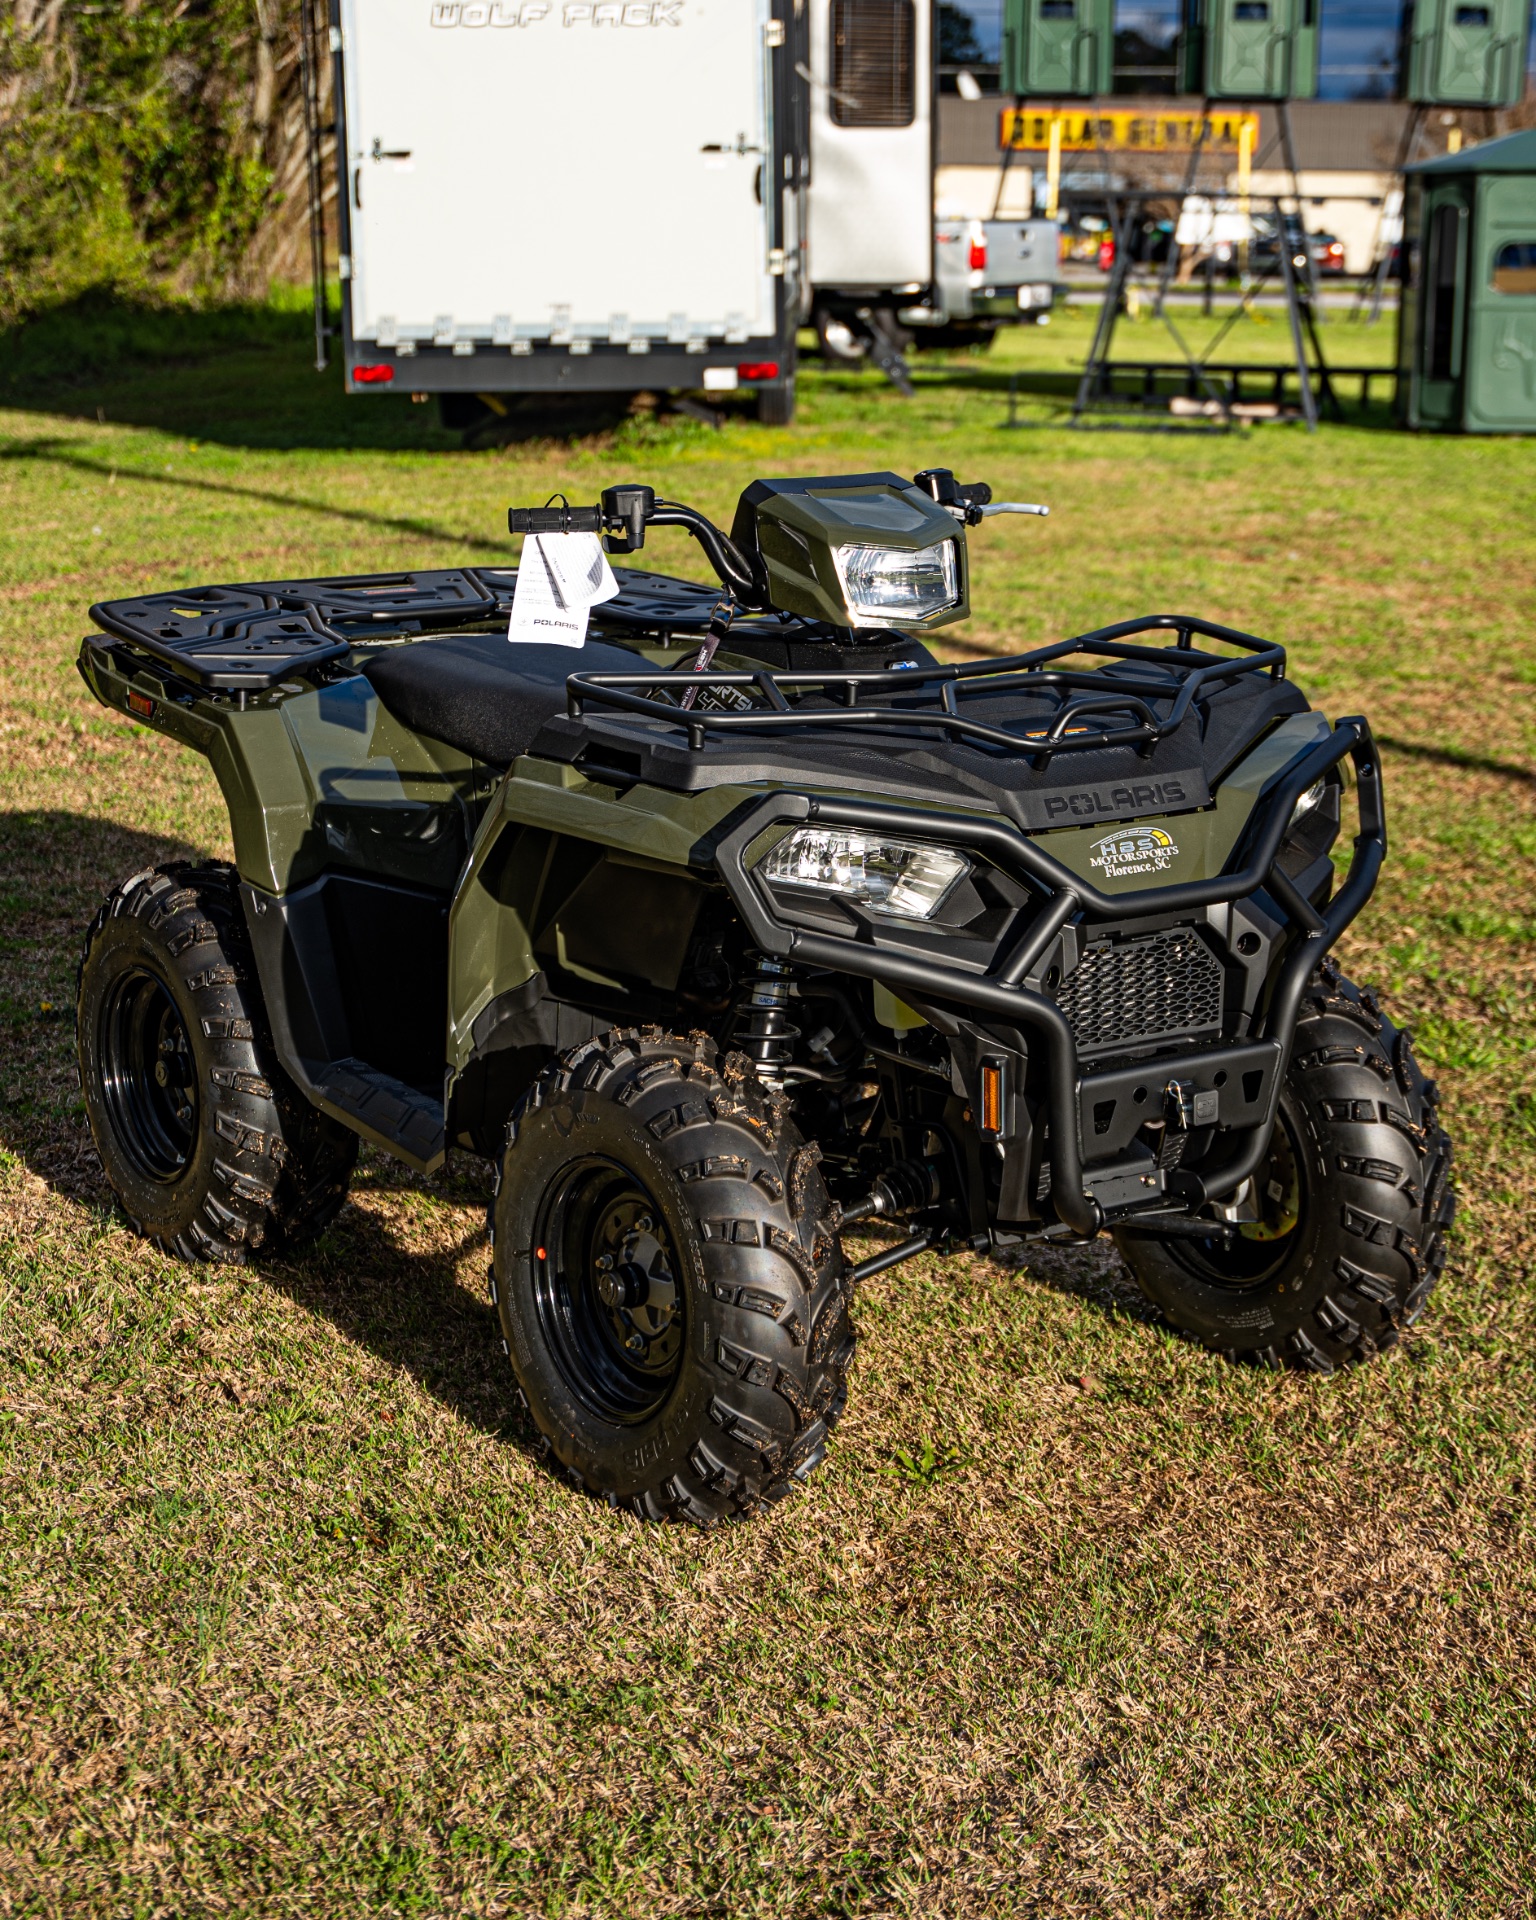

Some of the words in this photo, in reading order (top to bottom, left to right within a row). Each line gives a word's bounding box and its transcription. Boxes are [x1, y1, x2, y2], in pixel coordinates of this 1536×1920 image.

[430, 1, 551, 28] WOLF
[562, 1, 683, 28] PACK
[533, 618, 579, 631] POLARIS
[1044, 780, 1186, 819] POLARIS
[1089, 845, 1179, 868] MOTORSPORTS
[1100, 838, 1154, 856] HBS
[1103, 861, 1156, 878] Florence,
[1155, 856, 1172, 871] SC
